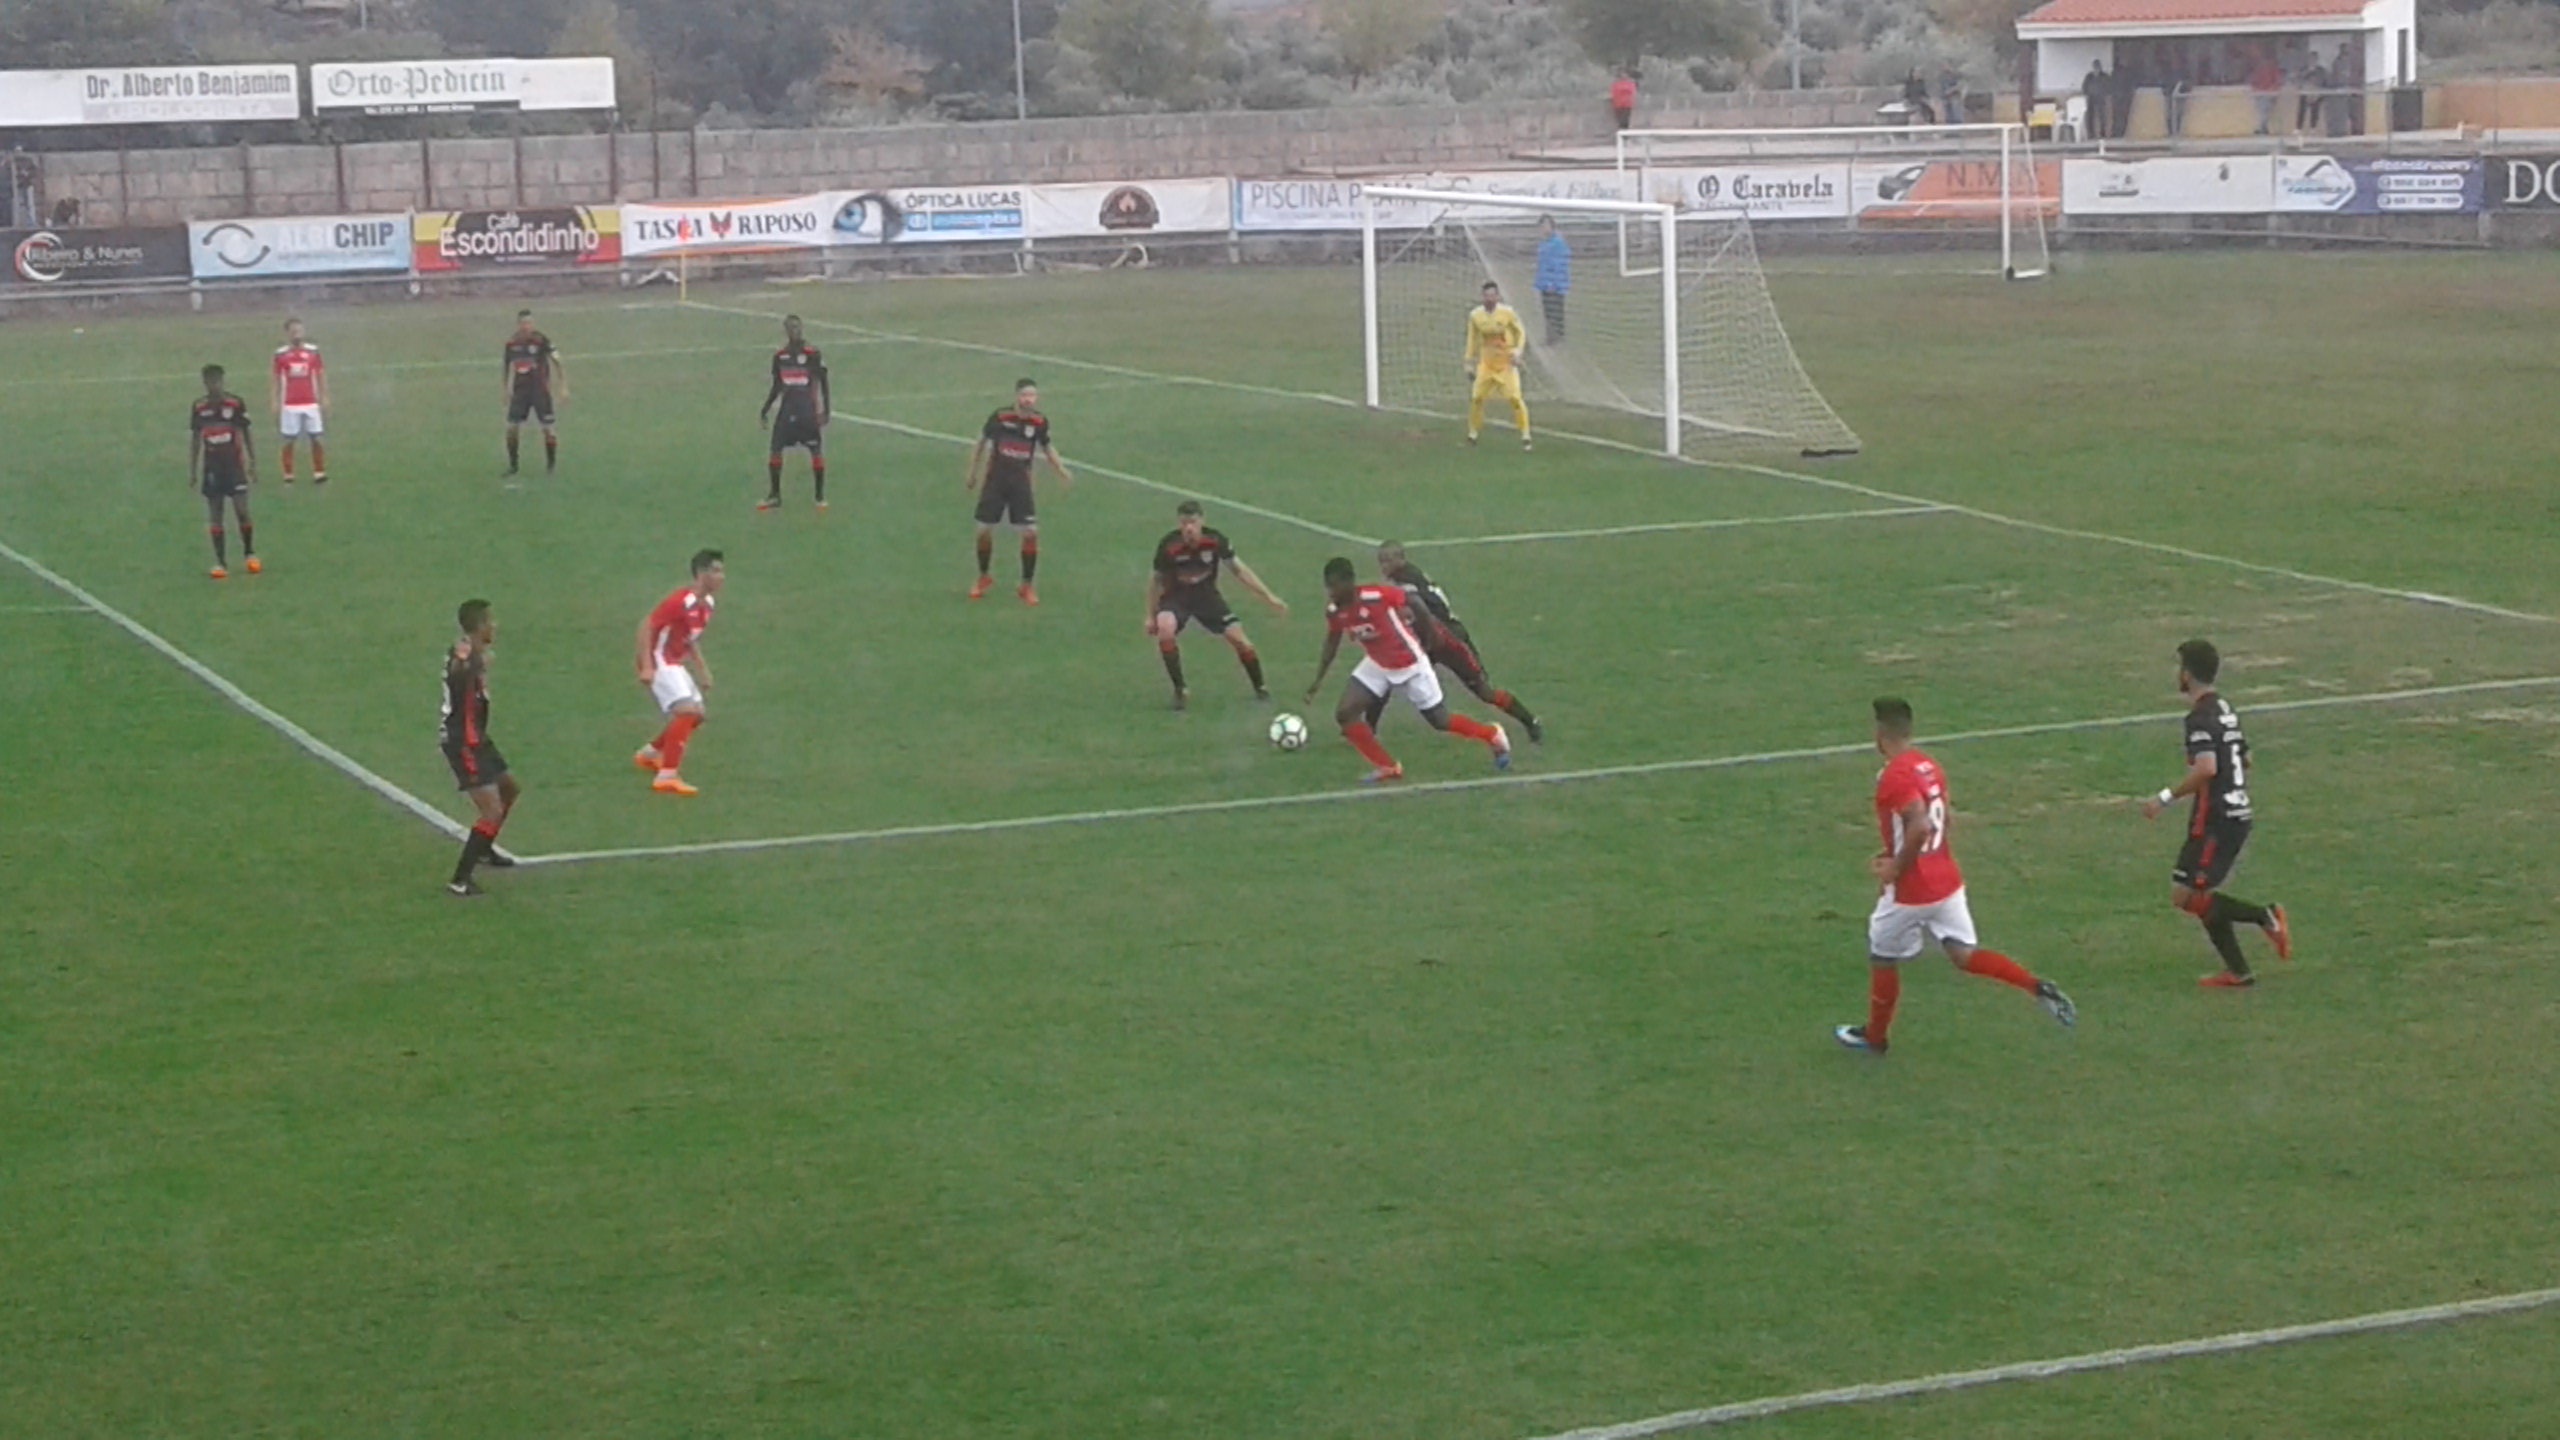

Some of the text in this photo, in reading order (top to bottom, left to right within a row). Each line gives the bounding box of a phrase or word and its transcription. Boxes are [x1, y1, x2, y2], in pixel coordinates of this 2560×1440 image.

[87, 70, 291, 98] Dr. Alberto Benjamim
[905, 190, 1021, 208] ÓPTICA LUCAS
[1251, 181, 1340, 210] PISCINA
[1698, 173, 1834, 200] O Caravela
[738, 211, 817, 234] RAPOSO
[440, 221, 599, 256] Escondidinho
